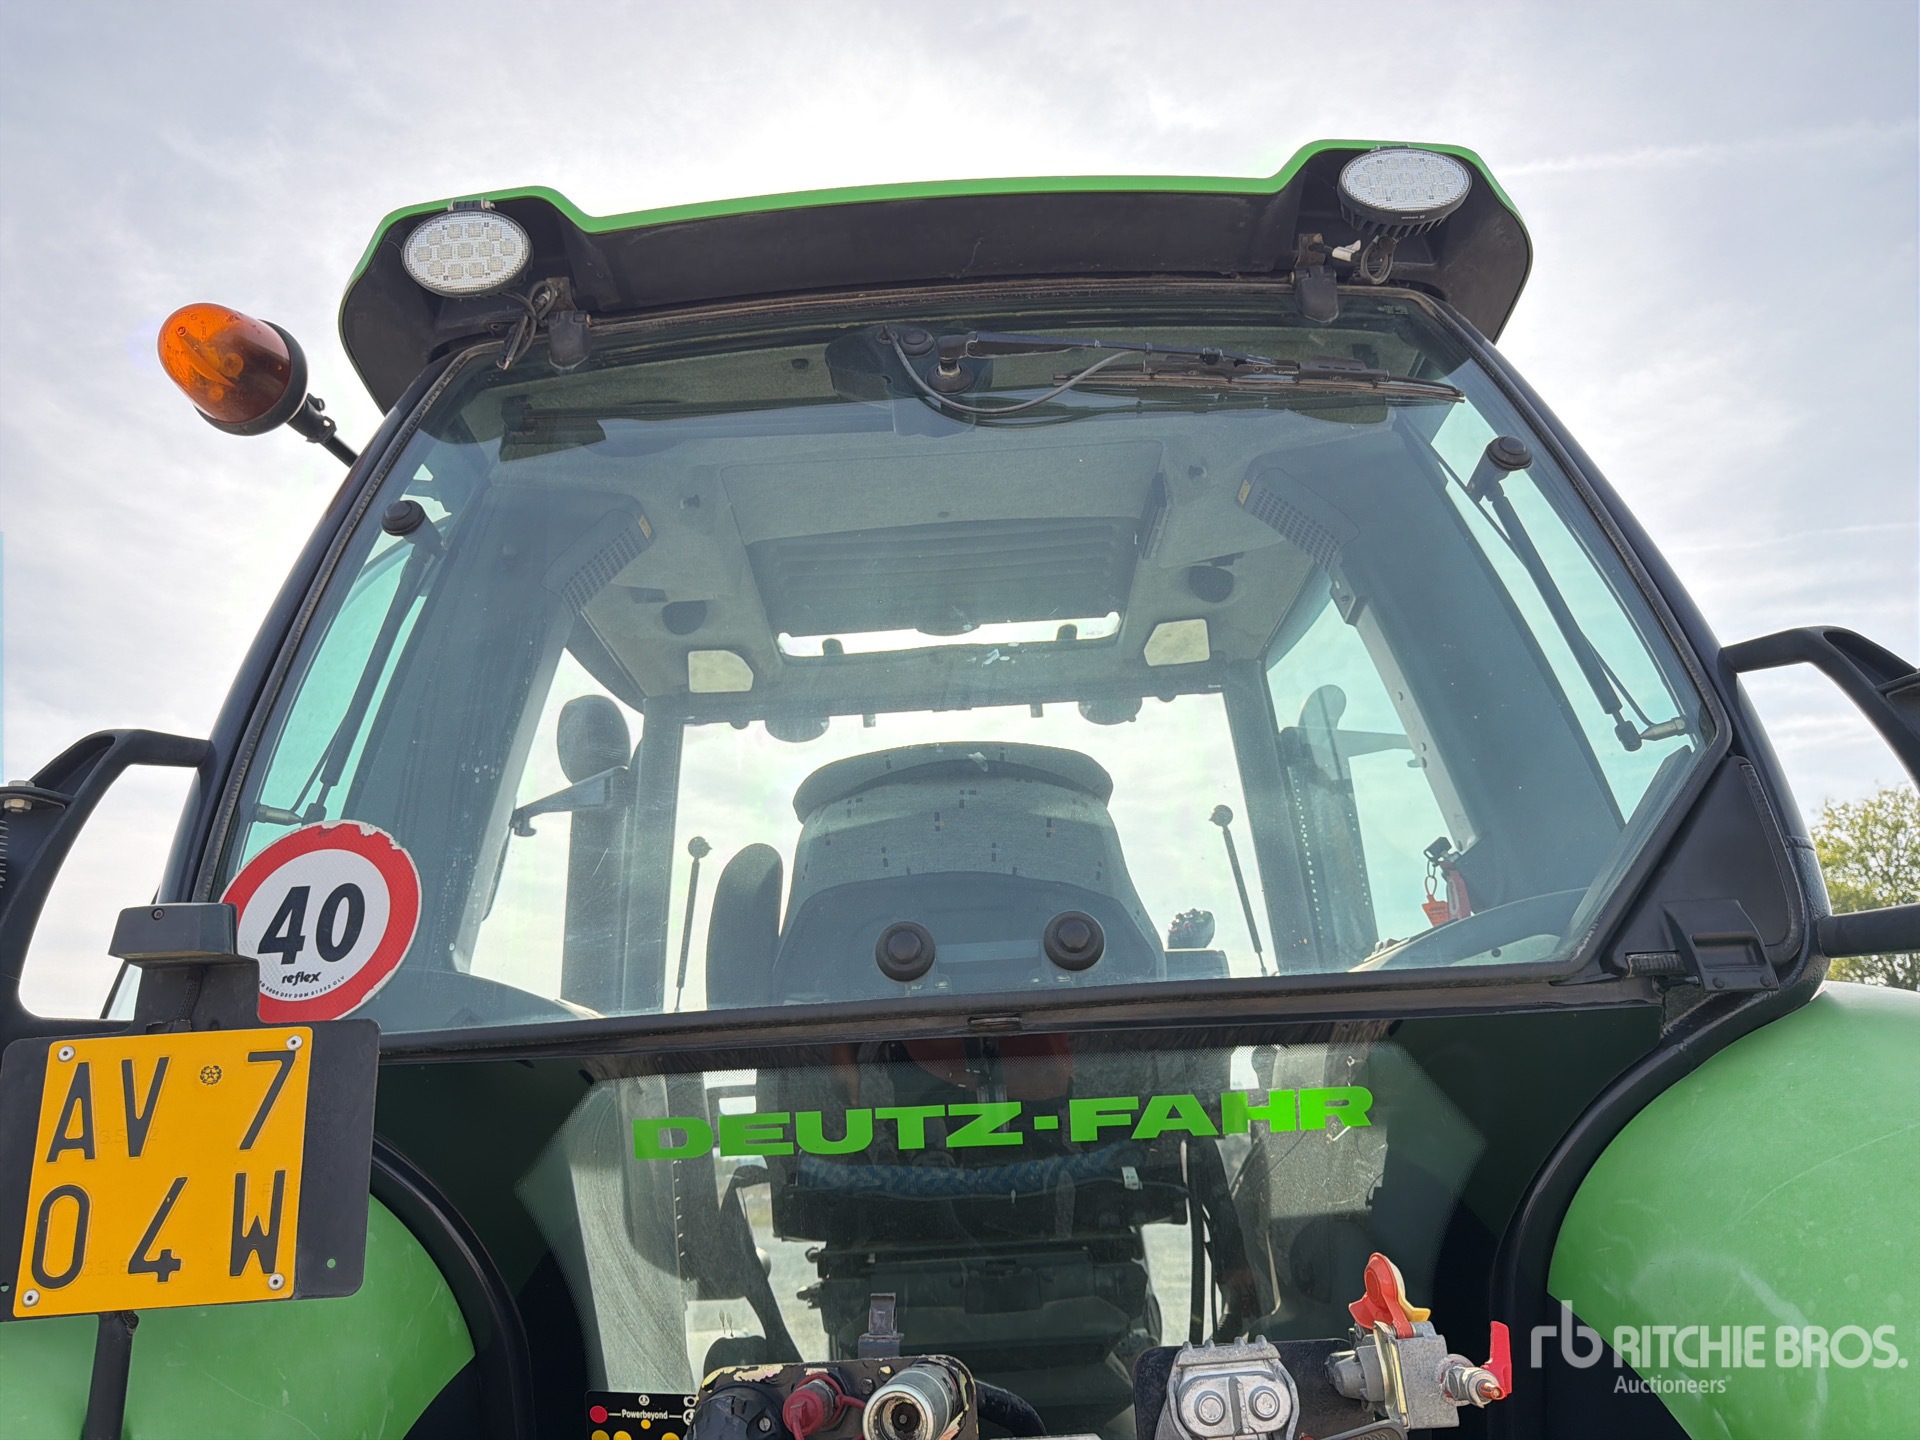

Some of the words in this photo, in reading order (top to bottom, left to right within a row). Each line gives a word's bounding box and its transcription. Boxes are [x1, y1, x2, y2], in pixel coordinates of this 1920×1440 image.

[257, 882, 366, 966] 40
[281, 971, 322, 986] reflex
[46, 1057, 170, 1162] AV
[240, 1051, 296, 1150] 7
[632, 1086, 1373, 1160] DEUTZ-FAHR
[622, 1409, 668, 1421] Powerbeyond
